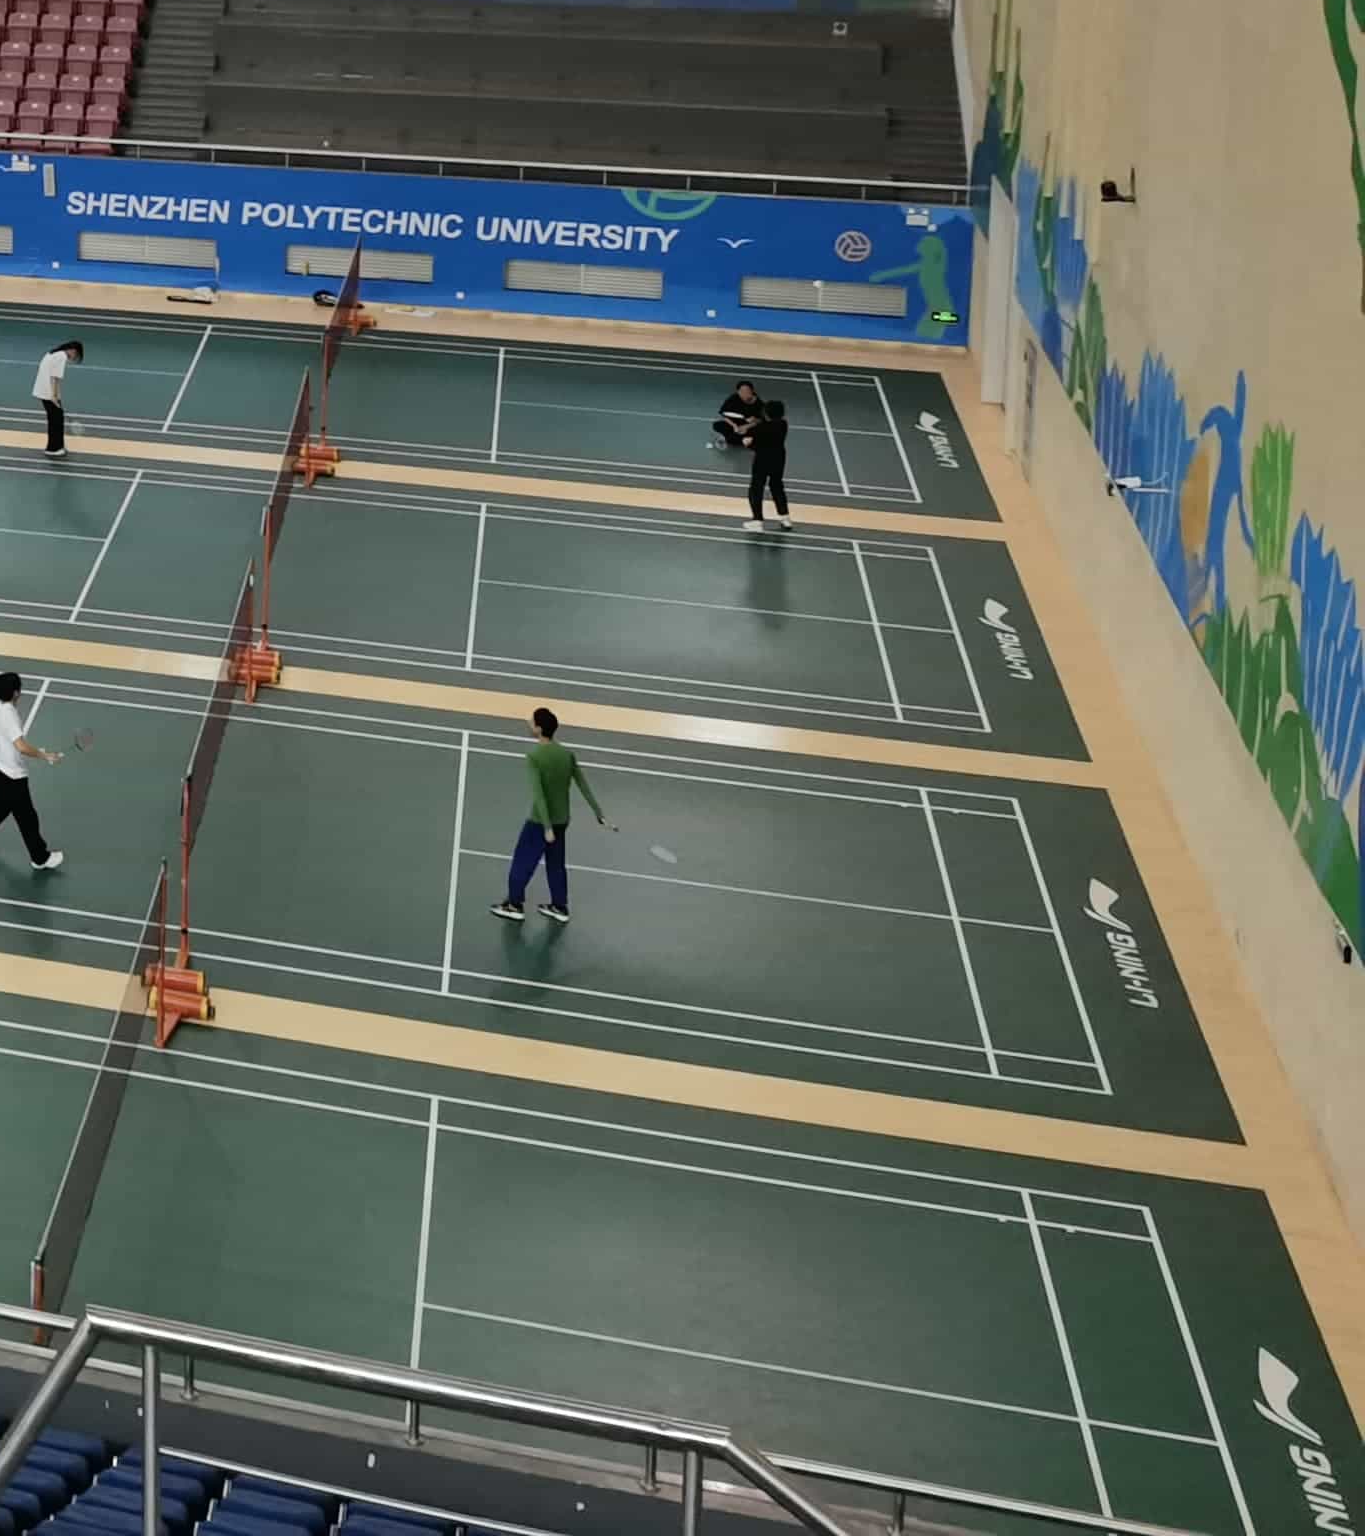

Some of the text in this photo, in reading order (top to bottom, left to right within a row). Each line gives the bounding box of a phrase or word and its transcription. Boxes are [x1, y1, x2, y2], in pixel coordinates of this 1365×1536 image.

[66, 191, 680, 253] SHENZHEN POLYTECHNIC UNIVERSITY
[1106, 930, 1161, 1010] LI-NING
